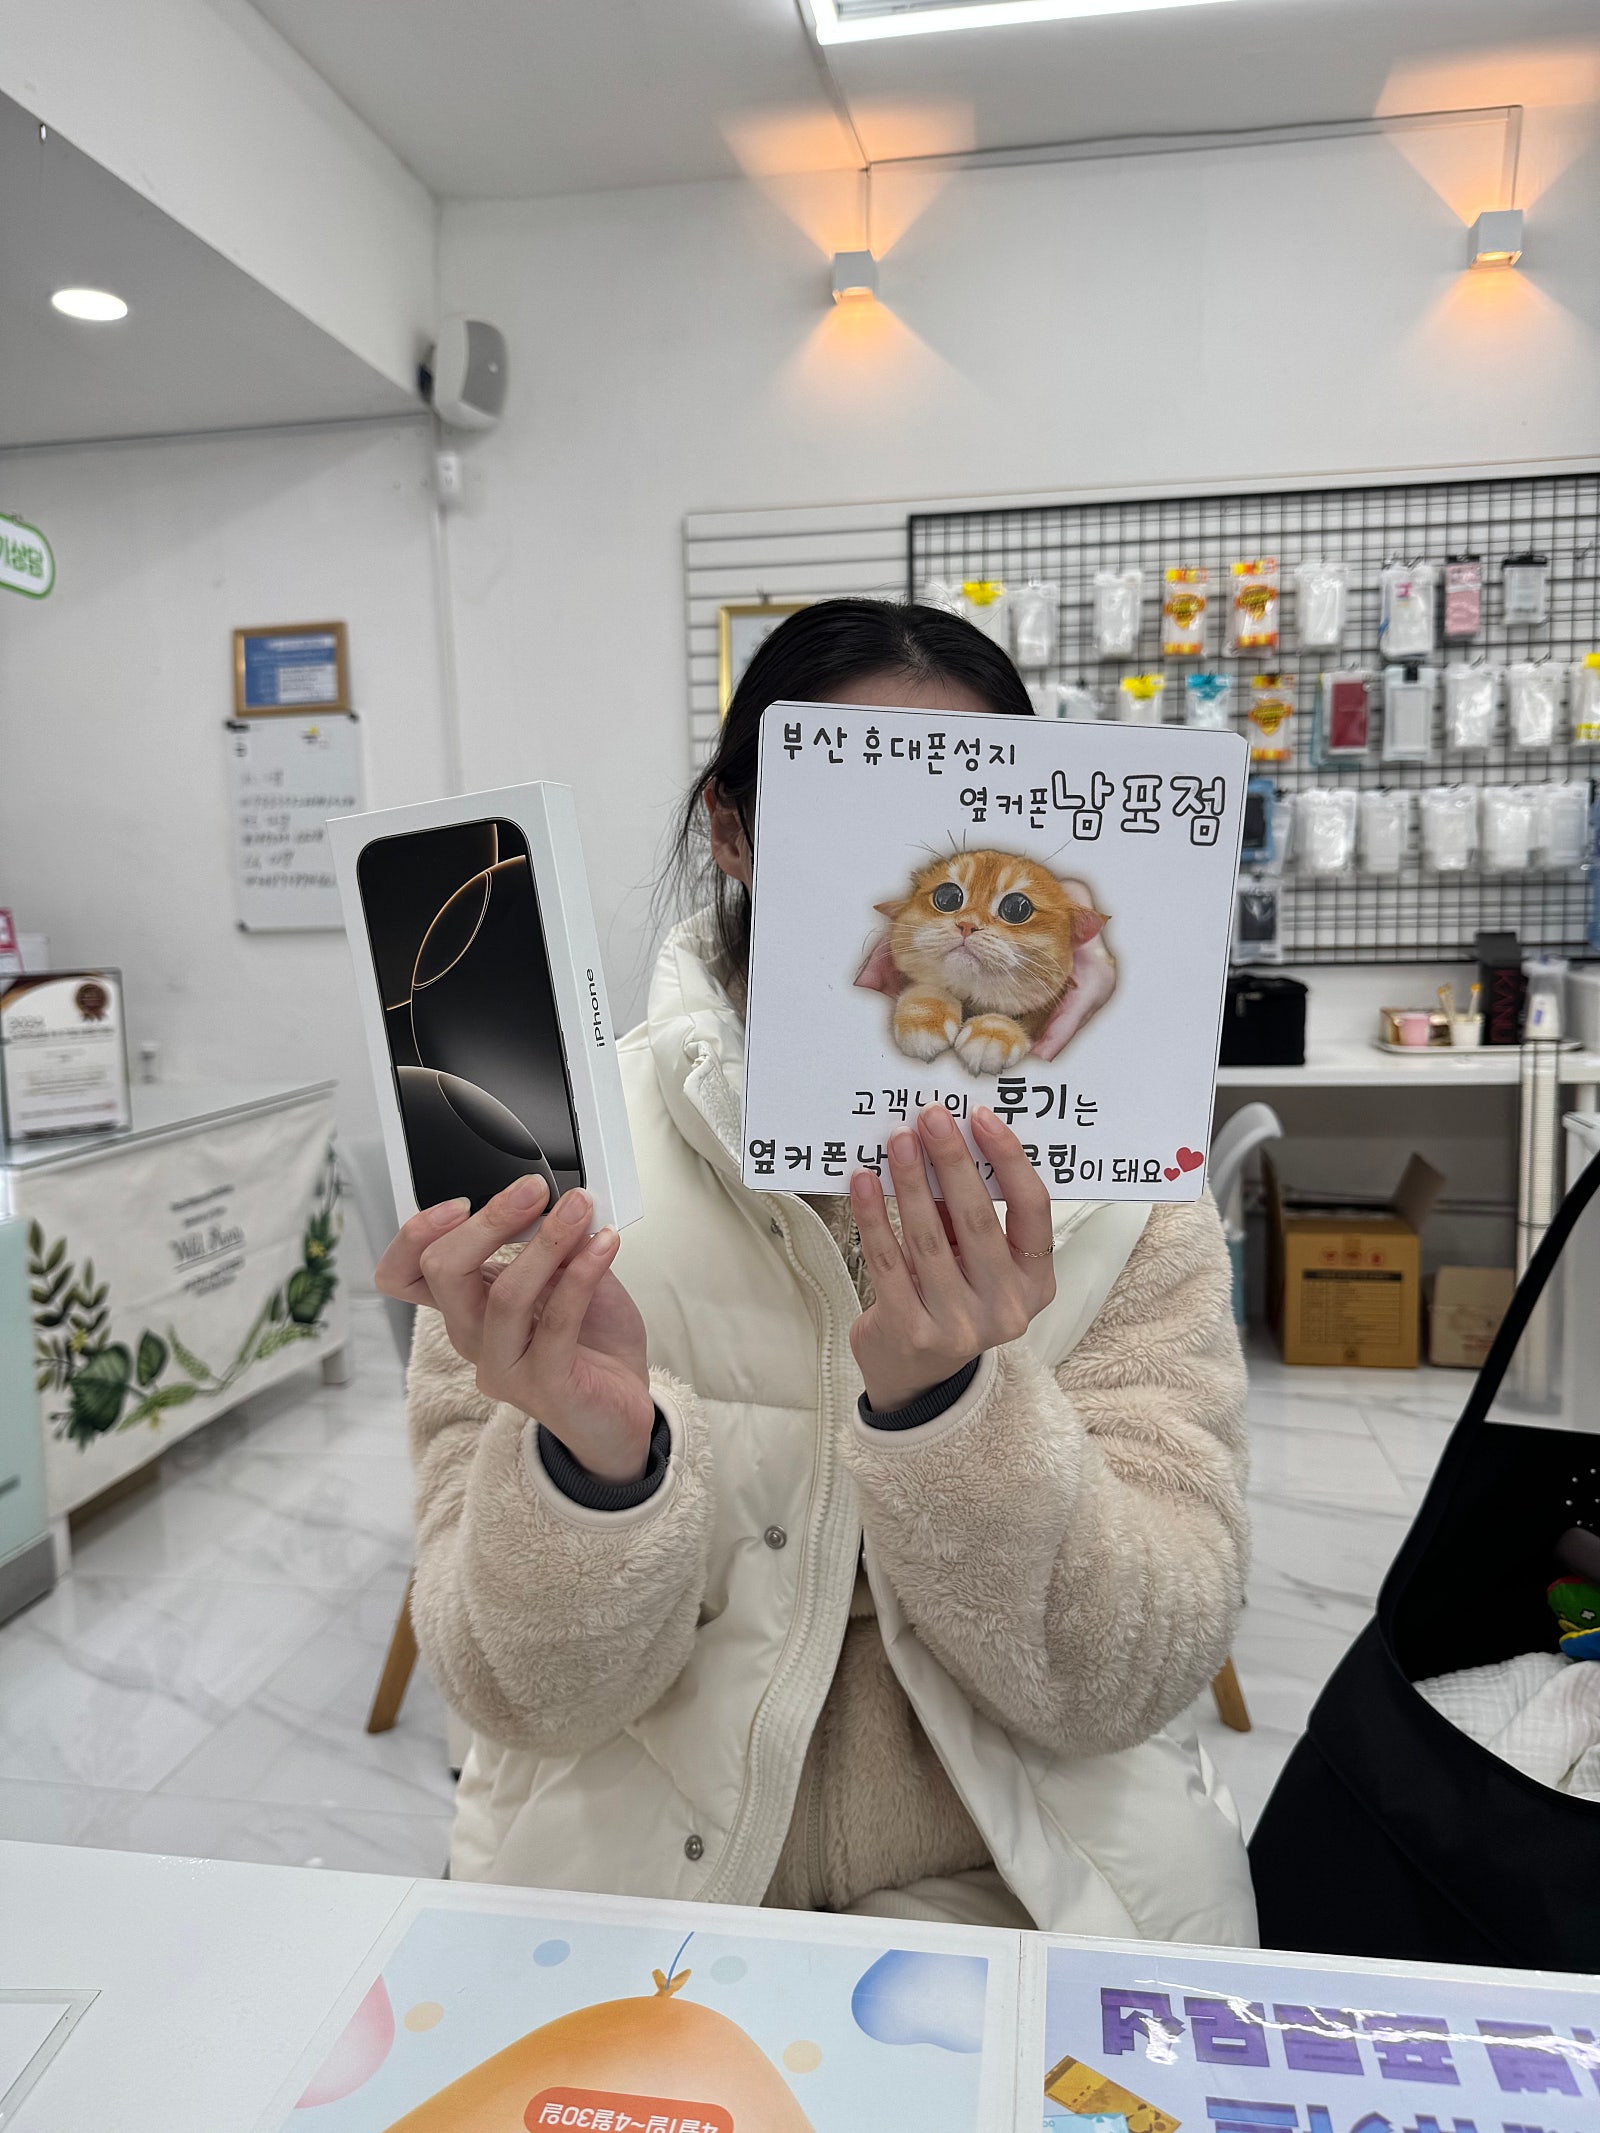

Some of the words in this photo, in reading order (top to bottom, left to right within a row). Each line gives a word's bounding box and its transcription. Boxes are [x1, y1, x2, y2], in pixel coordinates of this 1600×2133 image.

[783, 722, 848, 764] 부산
[863, 726, 1016, 775] 휴대폰성지
[586, 968, 605, 1047] iPhone
[993, 1077, 1098, 1127] 후기는
[1112, 1158, 1162, 1184] 돼요
